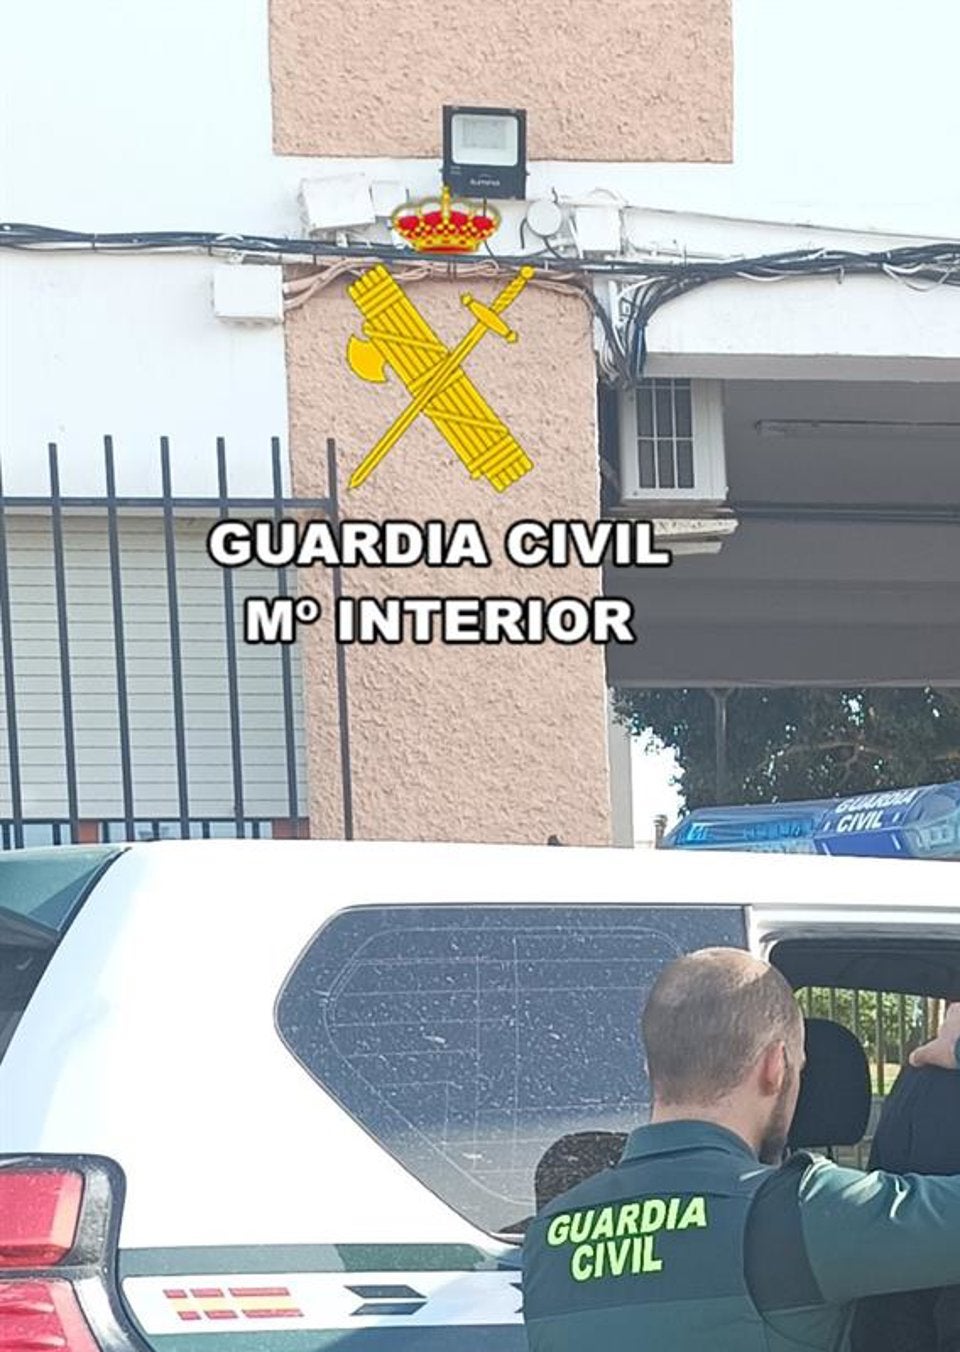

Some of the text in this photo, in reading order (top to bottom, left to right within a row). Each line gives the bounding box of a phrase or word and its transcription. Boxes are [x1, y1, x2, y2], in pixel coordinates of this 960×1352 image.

[835, 790, 918, 813] GUARDIA
[836, 810, 884, 832] CIVIL
[547, 1197, 707, 1245] GUARDIA
[571, 1235, 663, 1281] CIVIL
